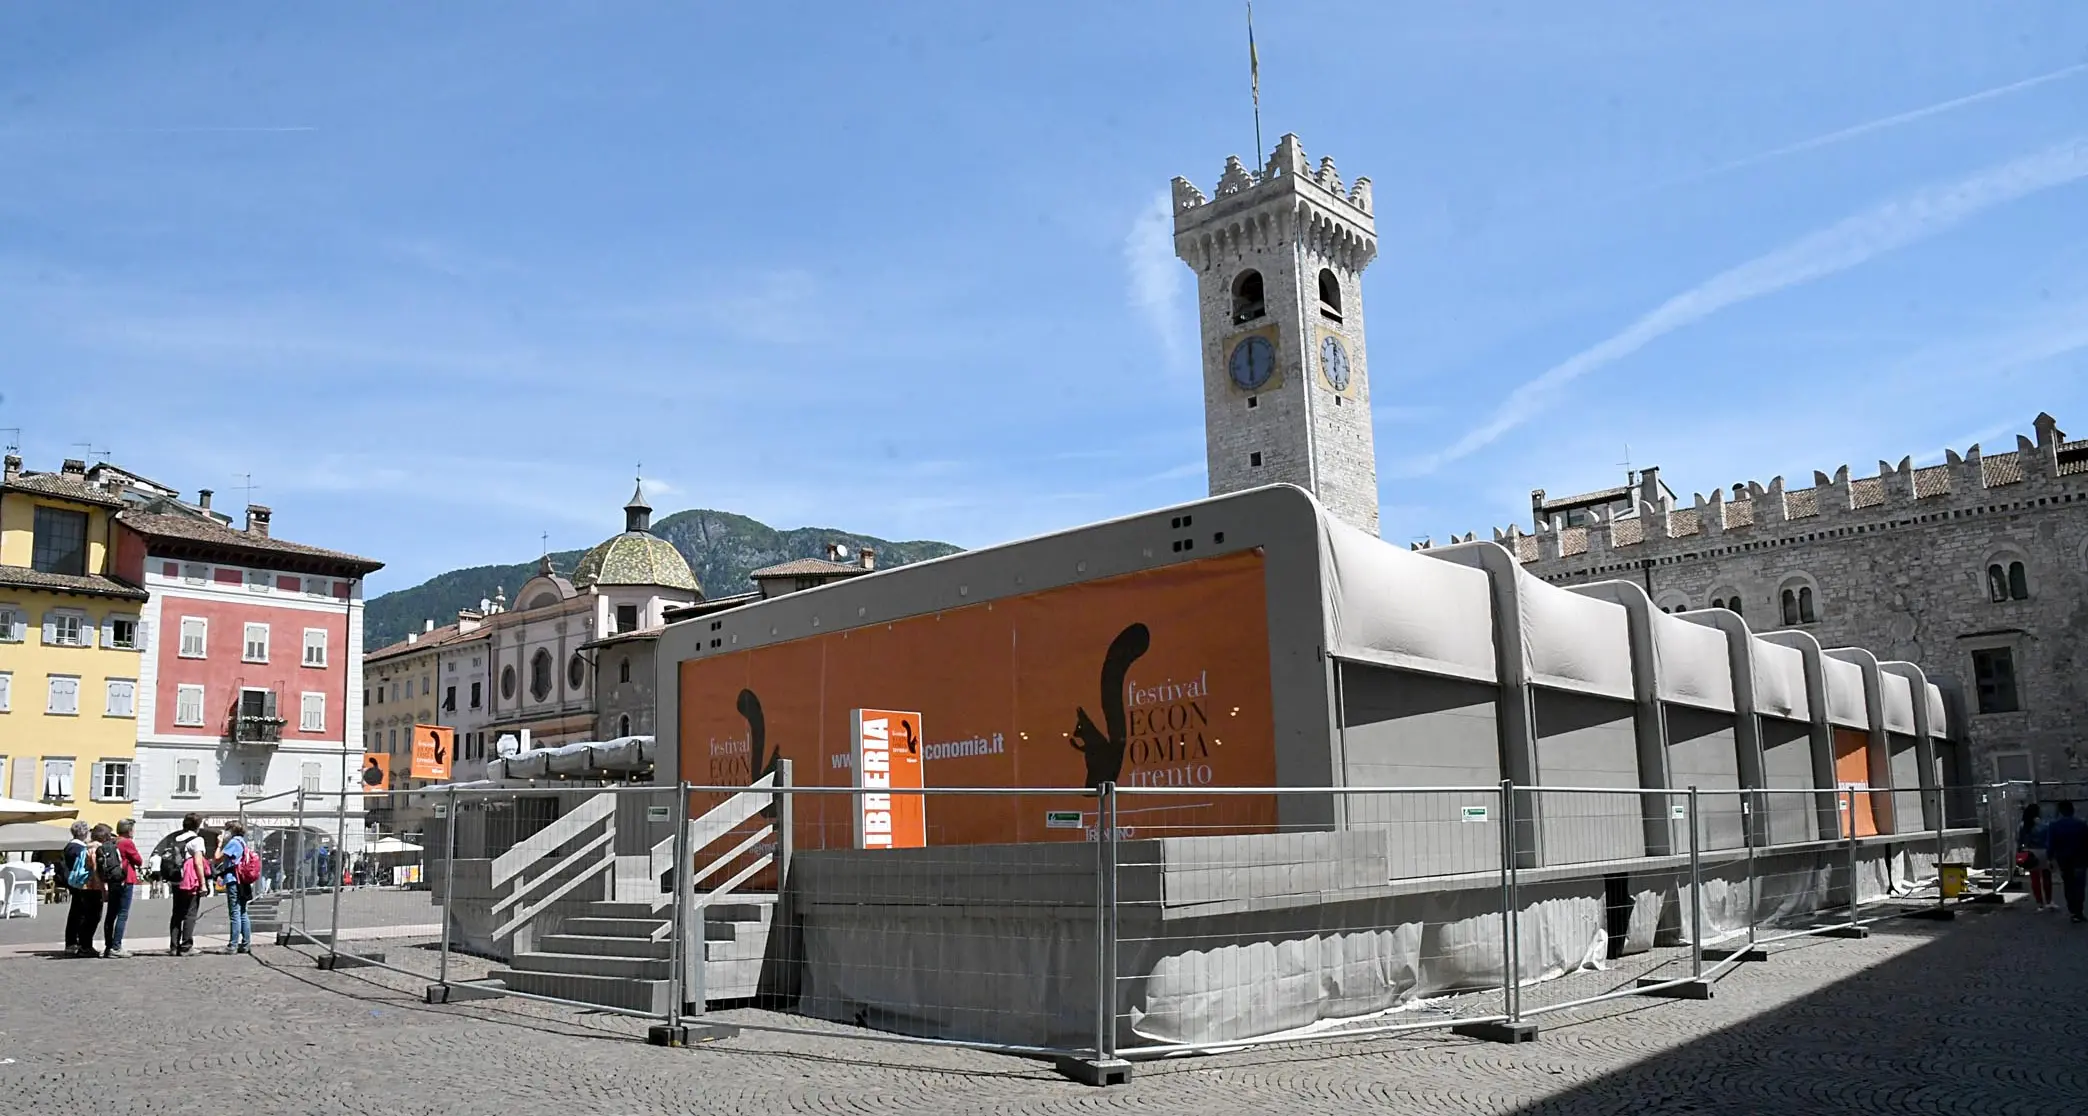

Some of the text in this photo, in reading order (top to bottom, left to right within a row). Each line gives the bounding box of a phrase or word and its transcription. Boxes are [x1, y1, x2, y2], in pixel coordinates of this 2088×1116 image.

[1128, 669, 1208, 707] festival
[1129, 699, 1208, 737] ECON
[709, 730, 750, 756] festival
[1129, 731, 1209, 766] OMIA
[709, 755, 751, 780] ECON
[863, 717, 892, 849] IBRERIA
[1129, 762, 1213, 788] trento
